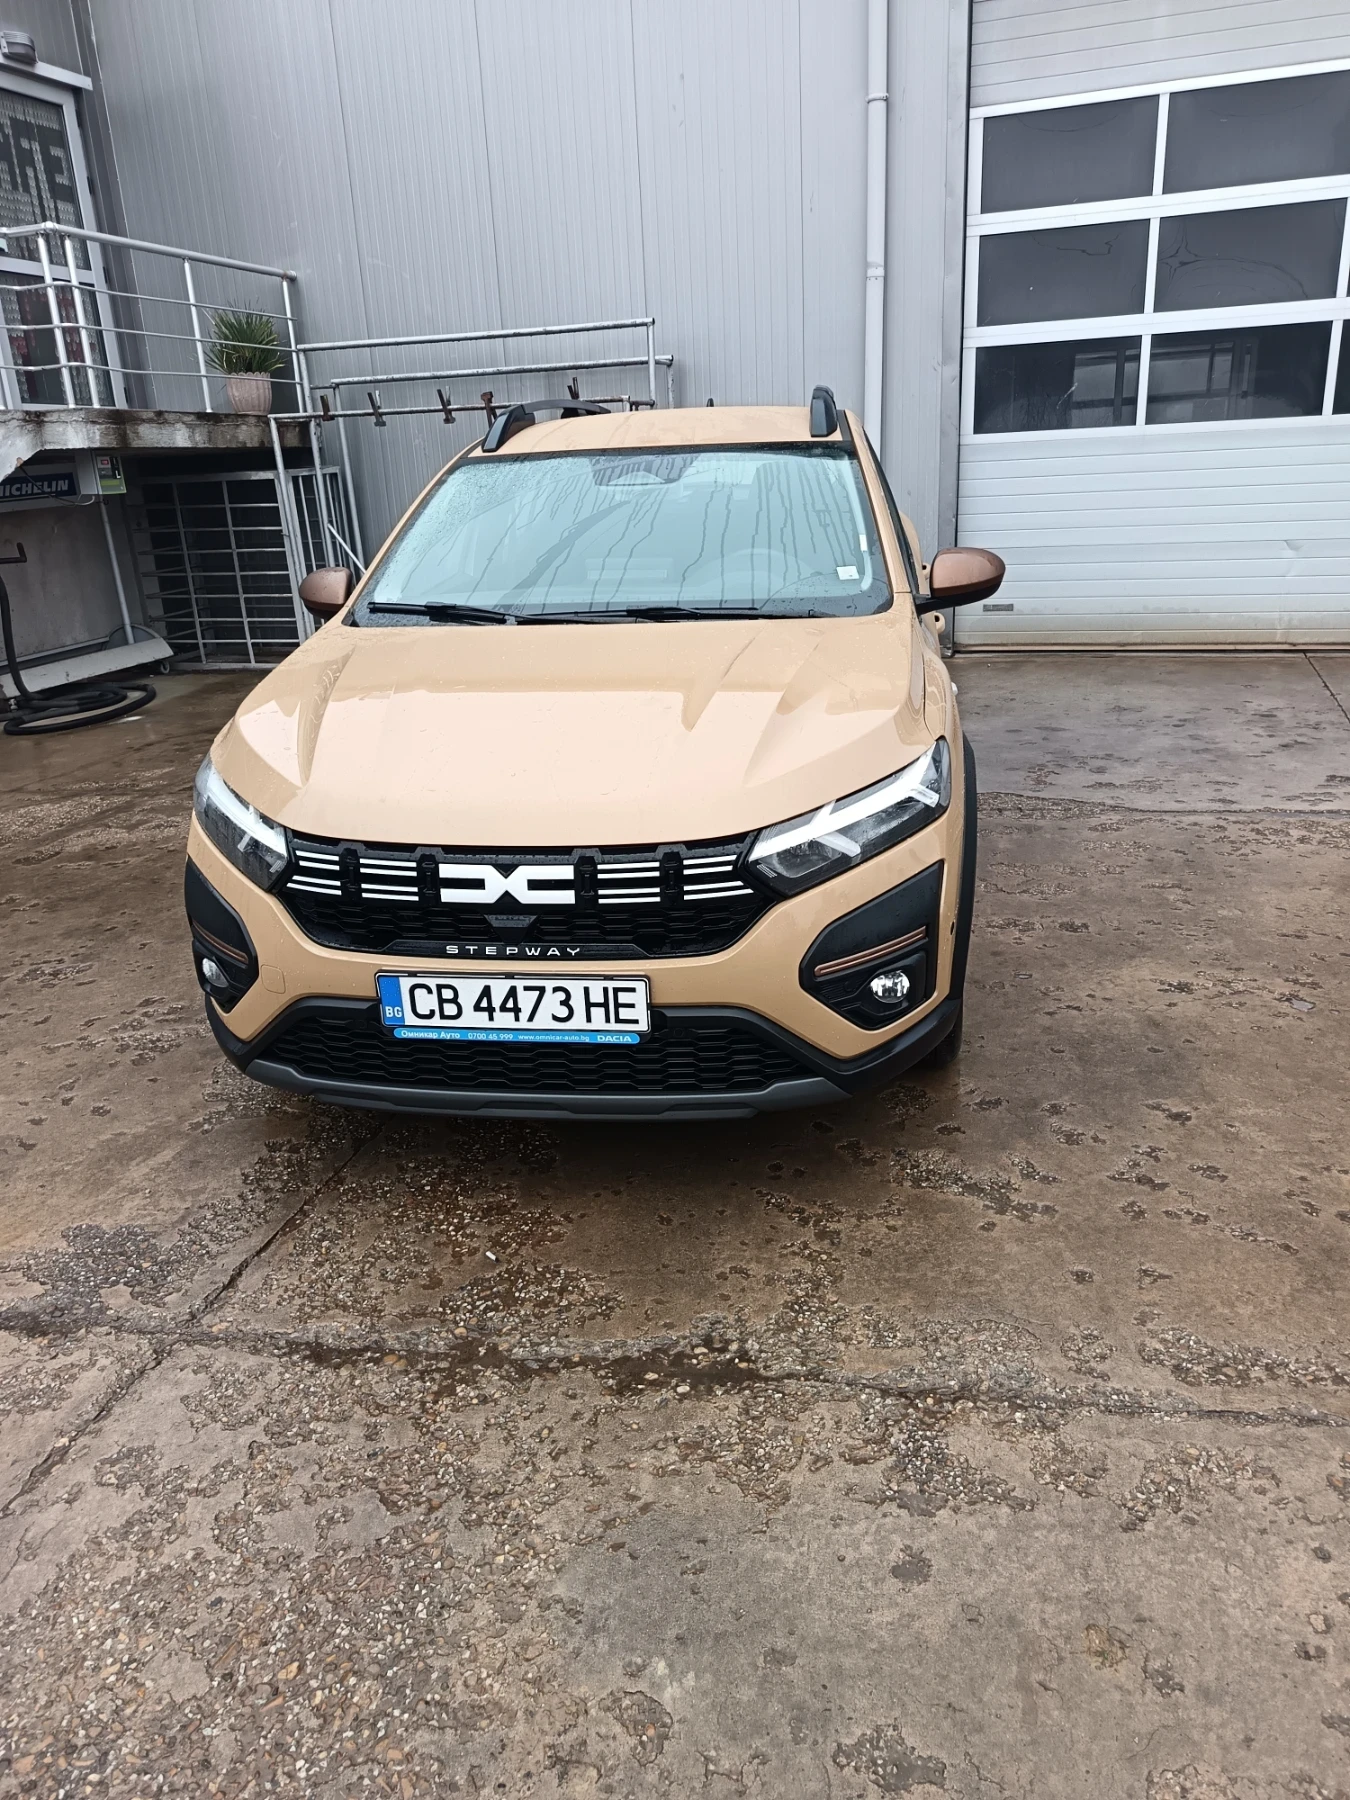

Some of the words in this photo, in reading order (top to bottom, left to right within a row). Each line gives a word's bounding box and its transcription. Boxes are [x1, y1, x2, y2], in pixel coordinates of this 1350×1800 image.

[446, 945, 581, 957] STEPWAY
[472, 984, 575, 1023] 4473
[385, 1006, 402, 1019] BG
[401, 1030, 438, 1039] Омникар
[440, 1031, 461, 1040] Ауто
[467, 1032, 487, 1040] 0700
[518, 1033, 590, 1042] www.omnicar-auto.bg
